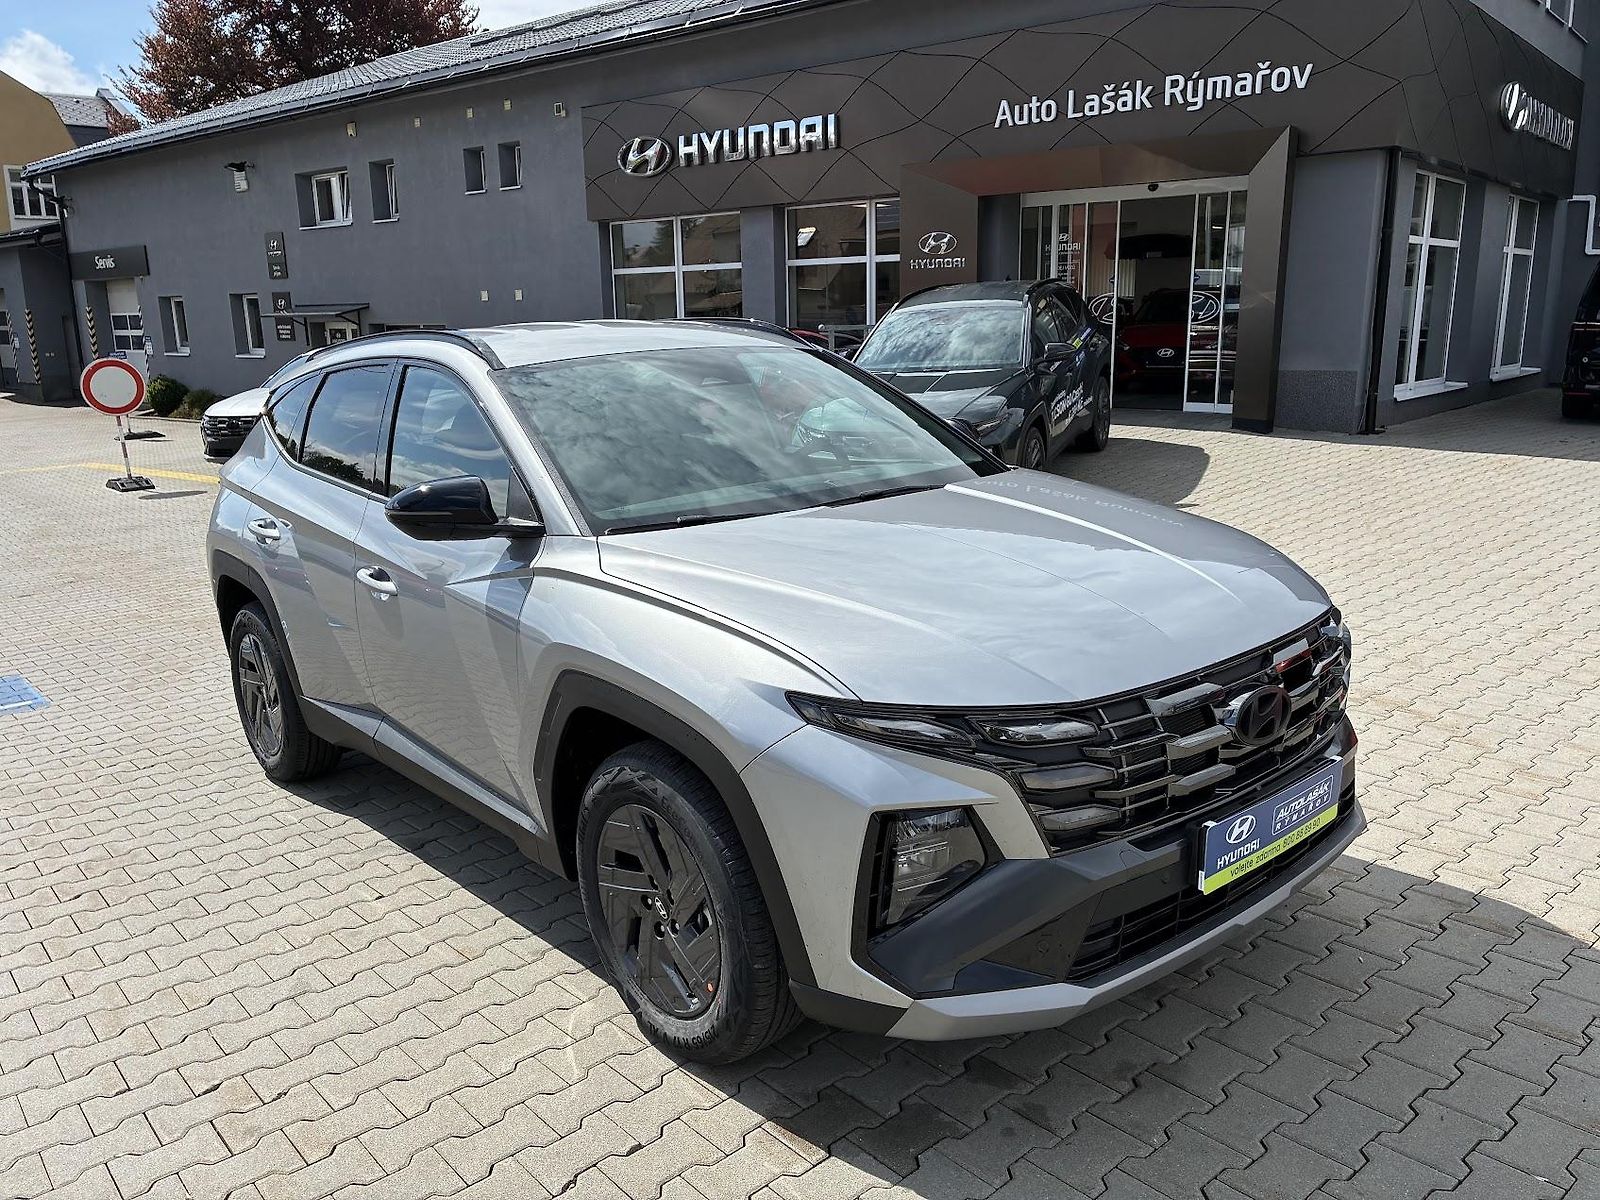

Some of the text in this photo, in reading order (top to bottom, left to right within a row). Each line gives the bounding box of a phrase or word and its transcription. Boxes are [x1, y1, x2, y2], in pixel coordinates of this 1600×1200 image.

[994, 61, 1314, 128] Auto Lašák Rýmařov
[678, 112, 840, 167] HYUNDAI
[94, 254, 116, 270] Servis
[910, 257, 966, 269] HYUNDAI
[1276, 781, 1330, 820] AUTOLAŠÁK
[1217, 838, 1260, 870] HYUNDAI
[1230, 859, 1254, 877] volejte
